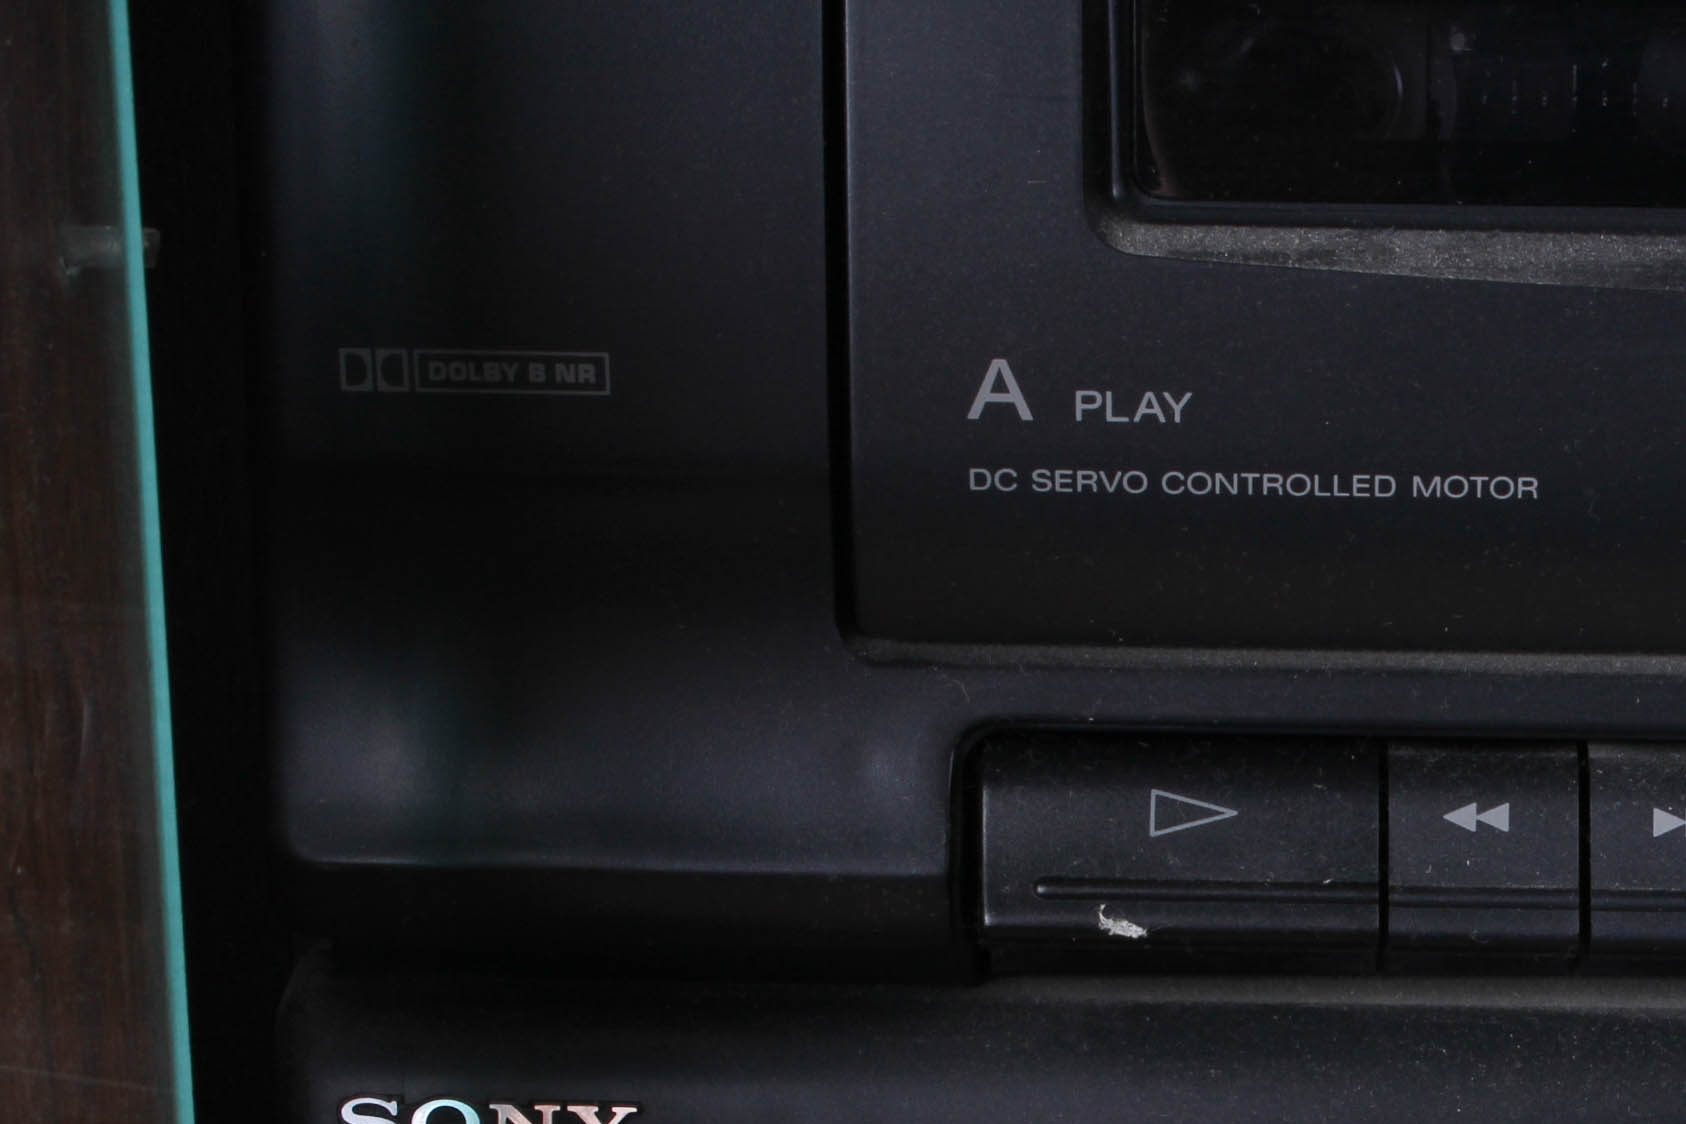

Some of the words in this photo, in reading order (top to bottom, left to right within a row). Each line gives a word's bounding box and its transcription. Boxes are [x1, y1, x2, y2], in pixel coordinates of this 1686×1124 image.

[427, 360, 519, 383] DOLBY
[528, 362, 547, 383] B
[554, 362, 597, 384] NR
[967, 358, 1034, 421] A
[1075, 390, 1193, 424] PLAY
[969, 467, 1018, 492] DC
[1031, 468, 1149, 494] SERVO
[1161, 471, 1397, 498] CONTROLLED
[1412, 474, 1539, 500] MOTOR
